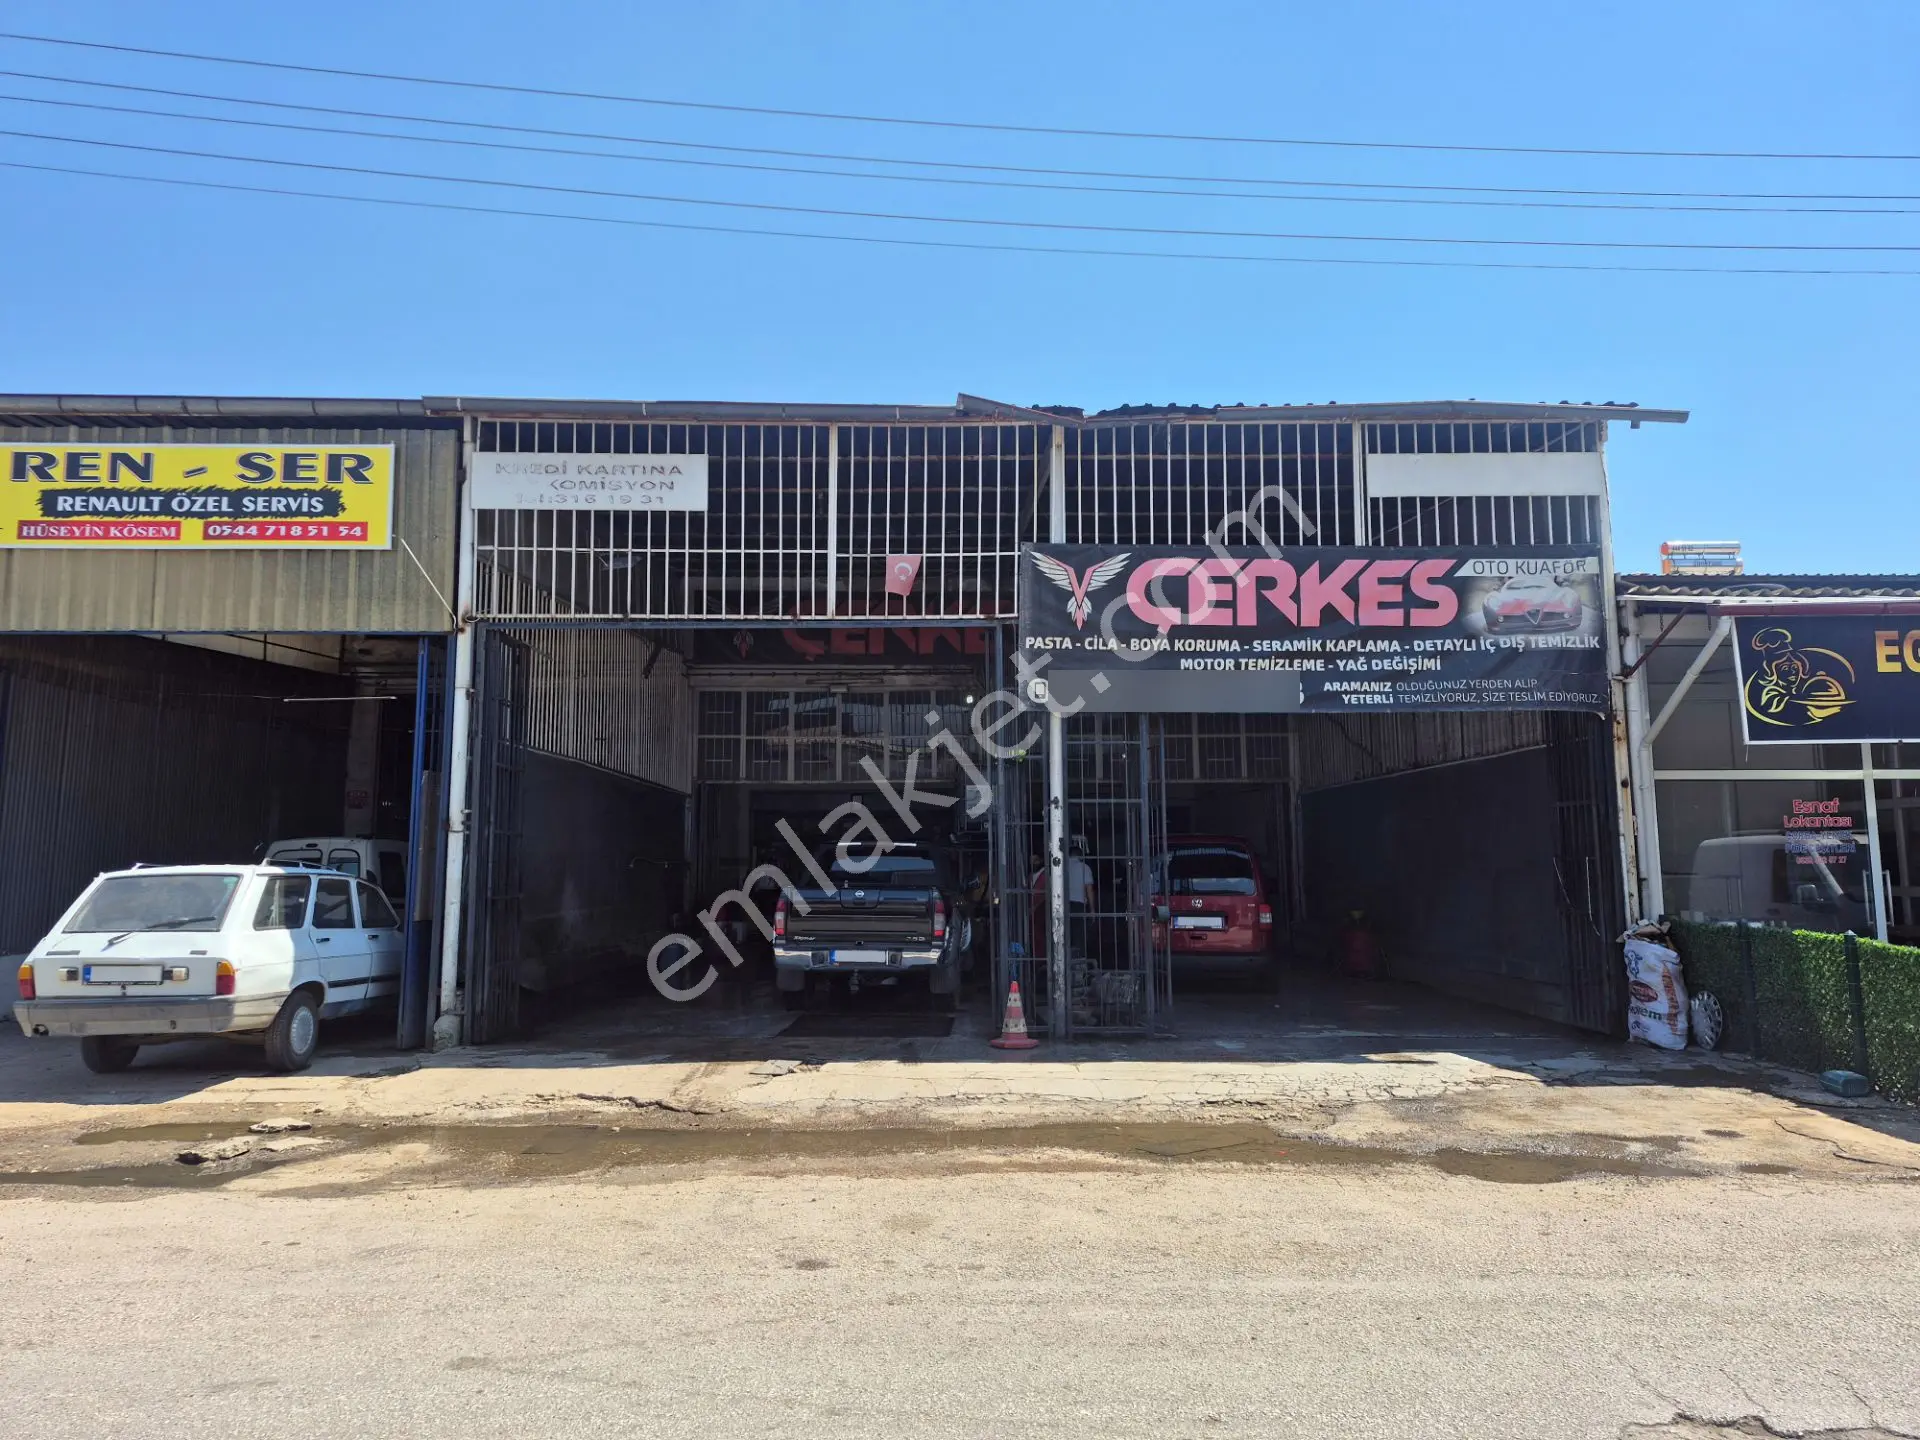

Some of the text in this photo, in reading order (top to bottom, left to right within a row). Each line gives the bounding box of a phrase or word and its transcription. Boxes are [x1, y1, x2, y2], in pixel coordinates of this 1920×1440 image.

[10, 451, 155, 483] REN
[235, 452, 374, 484] SER
[577, 464, 684, 476] KARTINA
[56, 492, 324, 512] RENAULT ÖZEL SERVİS
[21, 523, 177, 538] HÜSEYİN KÖSEM
[207, 525, 363, 537] 0544 718 51 54
[1472, 559, 1586, 575] OTO KUAFÖR
[1126, 557, 1458, 634] ÇERKES
[1025, 636, 1073, 650] PASTA
[1084, 634, 1118, 650] CİLA
[1130, 638, 1170, 651] BOYA
[1174, 639, 1240, 652] KORUMA
[1252, 637, 1322, 652] SERAMİK
[1325, 639, 1401, 653] KAPLAMA
[1413, 638, 1477, 652] DETAYLI
[1480, 636, 1496, 653] İÇ
[1500, 636, 1525, 653] DIŞ
[1529, 633, 1600, 650] TEMİZLİK
[1180, 658, 1236, 671] MOTOR
[1239, 655, 1325, 671] TEMİZLEME
[1336, 656, 1368, 671] YAĞ
[1371, 656, 1441, 674] DEĞİŞİMİ
[1323, 681, 1392, 692] ARAMANIZ
[1396, 679, 1467, 691] OLDUĞUNUZ
[1470, 679, 1512, 689] YERDEN
[1509, 690, 1546, 701] TESLİM
[1793, 798, 1840, 814] Esnaf
[1783, 815, 1853, 828] Lokantası
